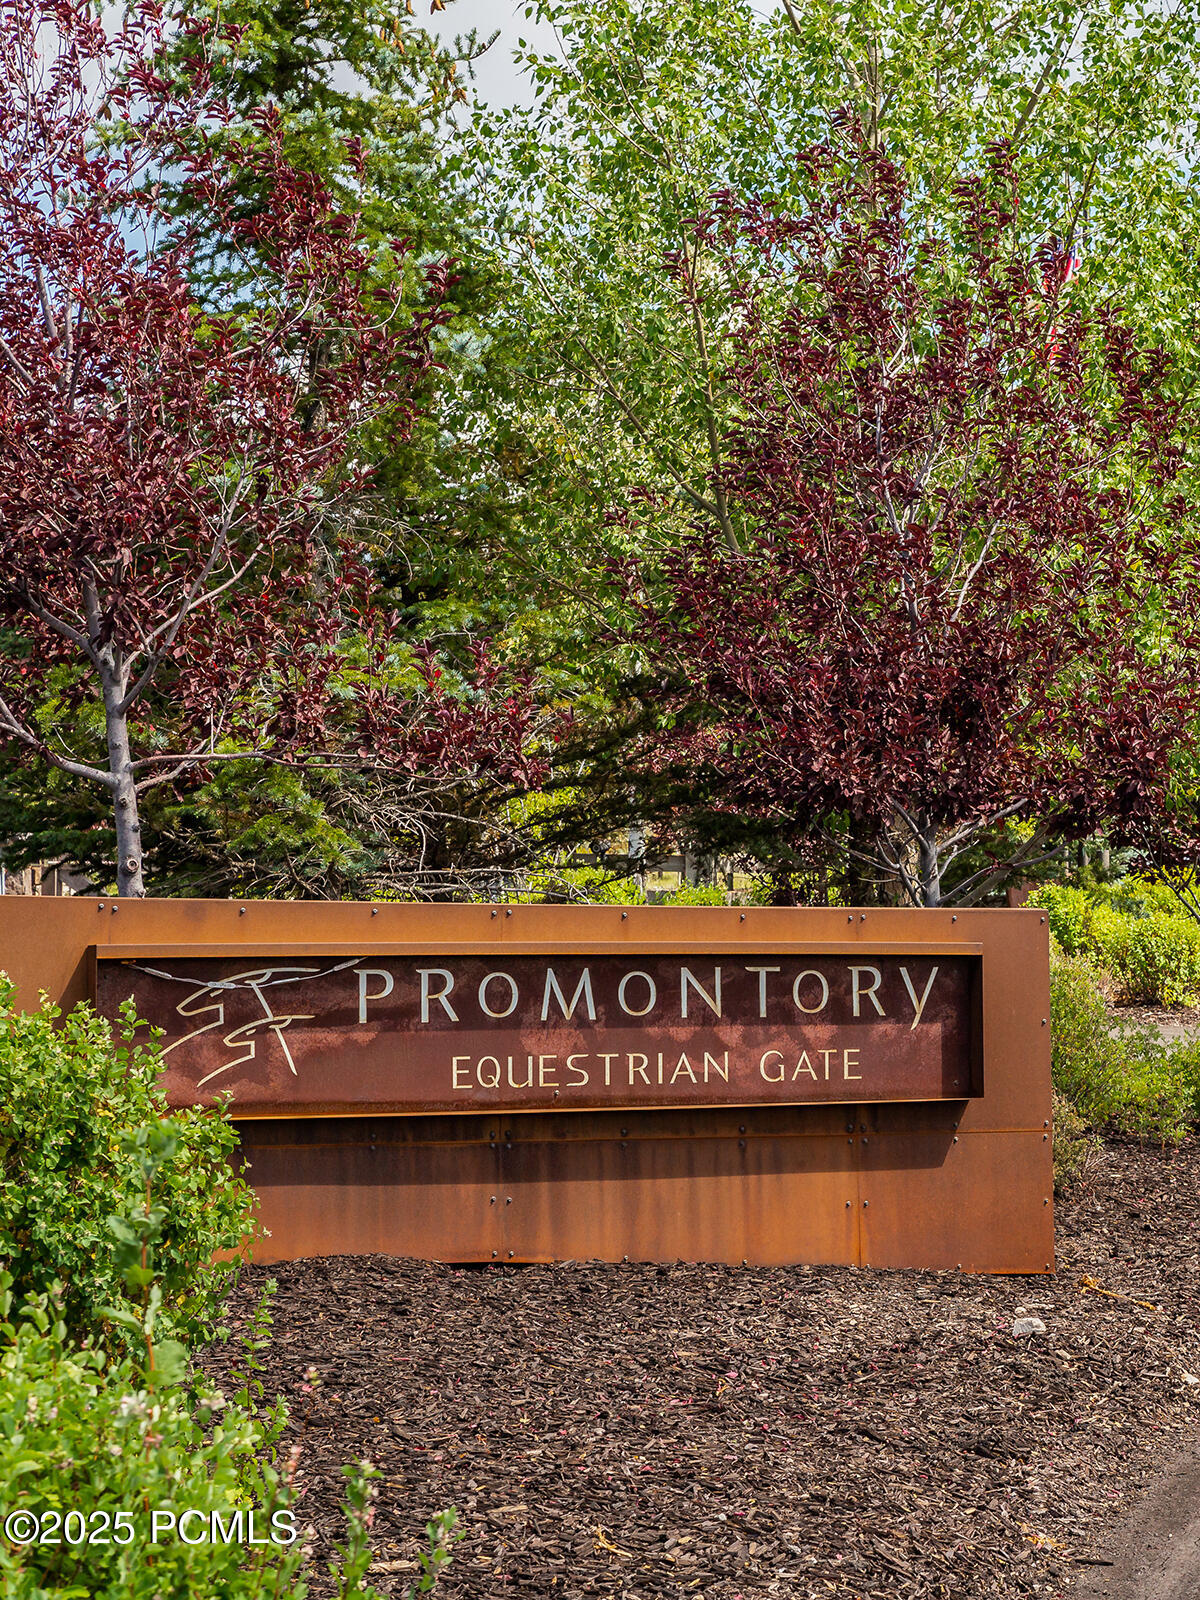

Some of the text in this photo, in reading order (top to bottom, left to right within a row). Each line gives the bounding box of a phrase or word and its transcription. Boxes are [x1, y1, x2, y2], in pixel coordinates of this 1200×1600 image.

[352, 966, 939, 1031] PROMONTORY
[451, 1049, 863, 1089] EQUESTRIAN GATE
